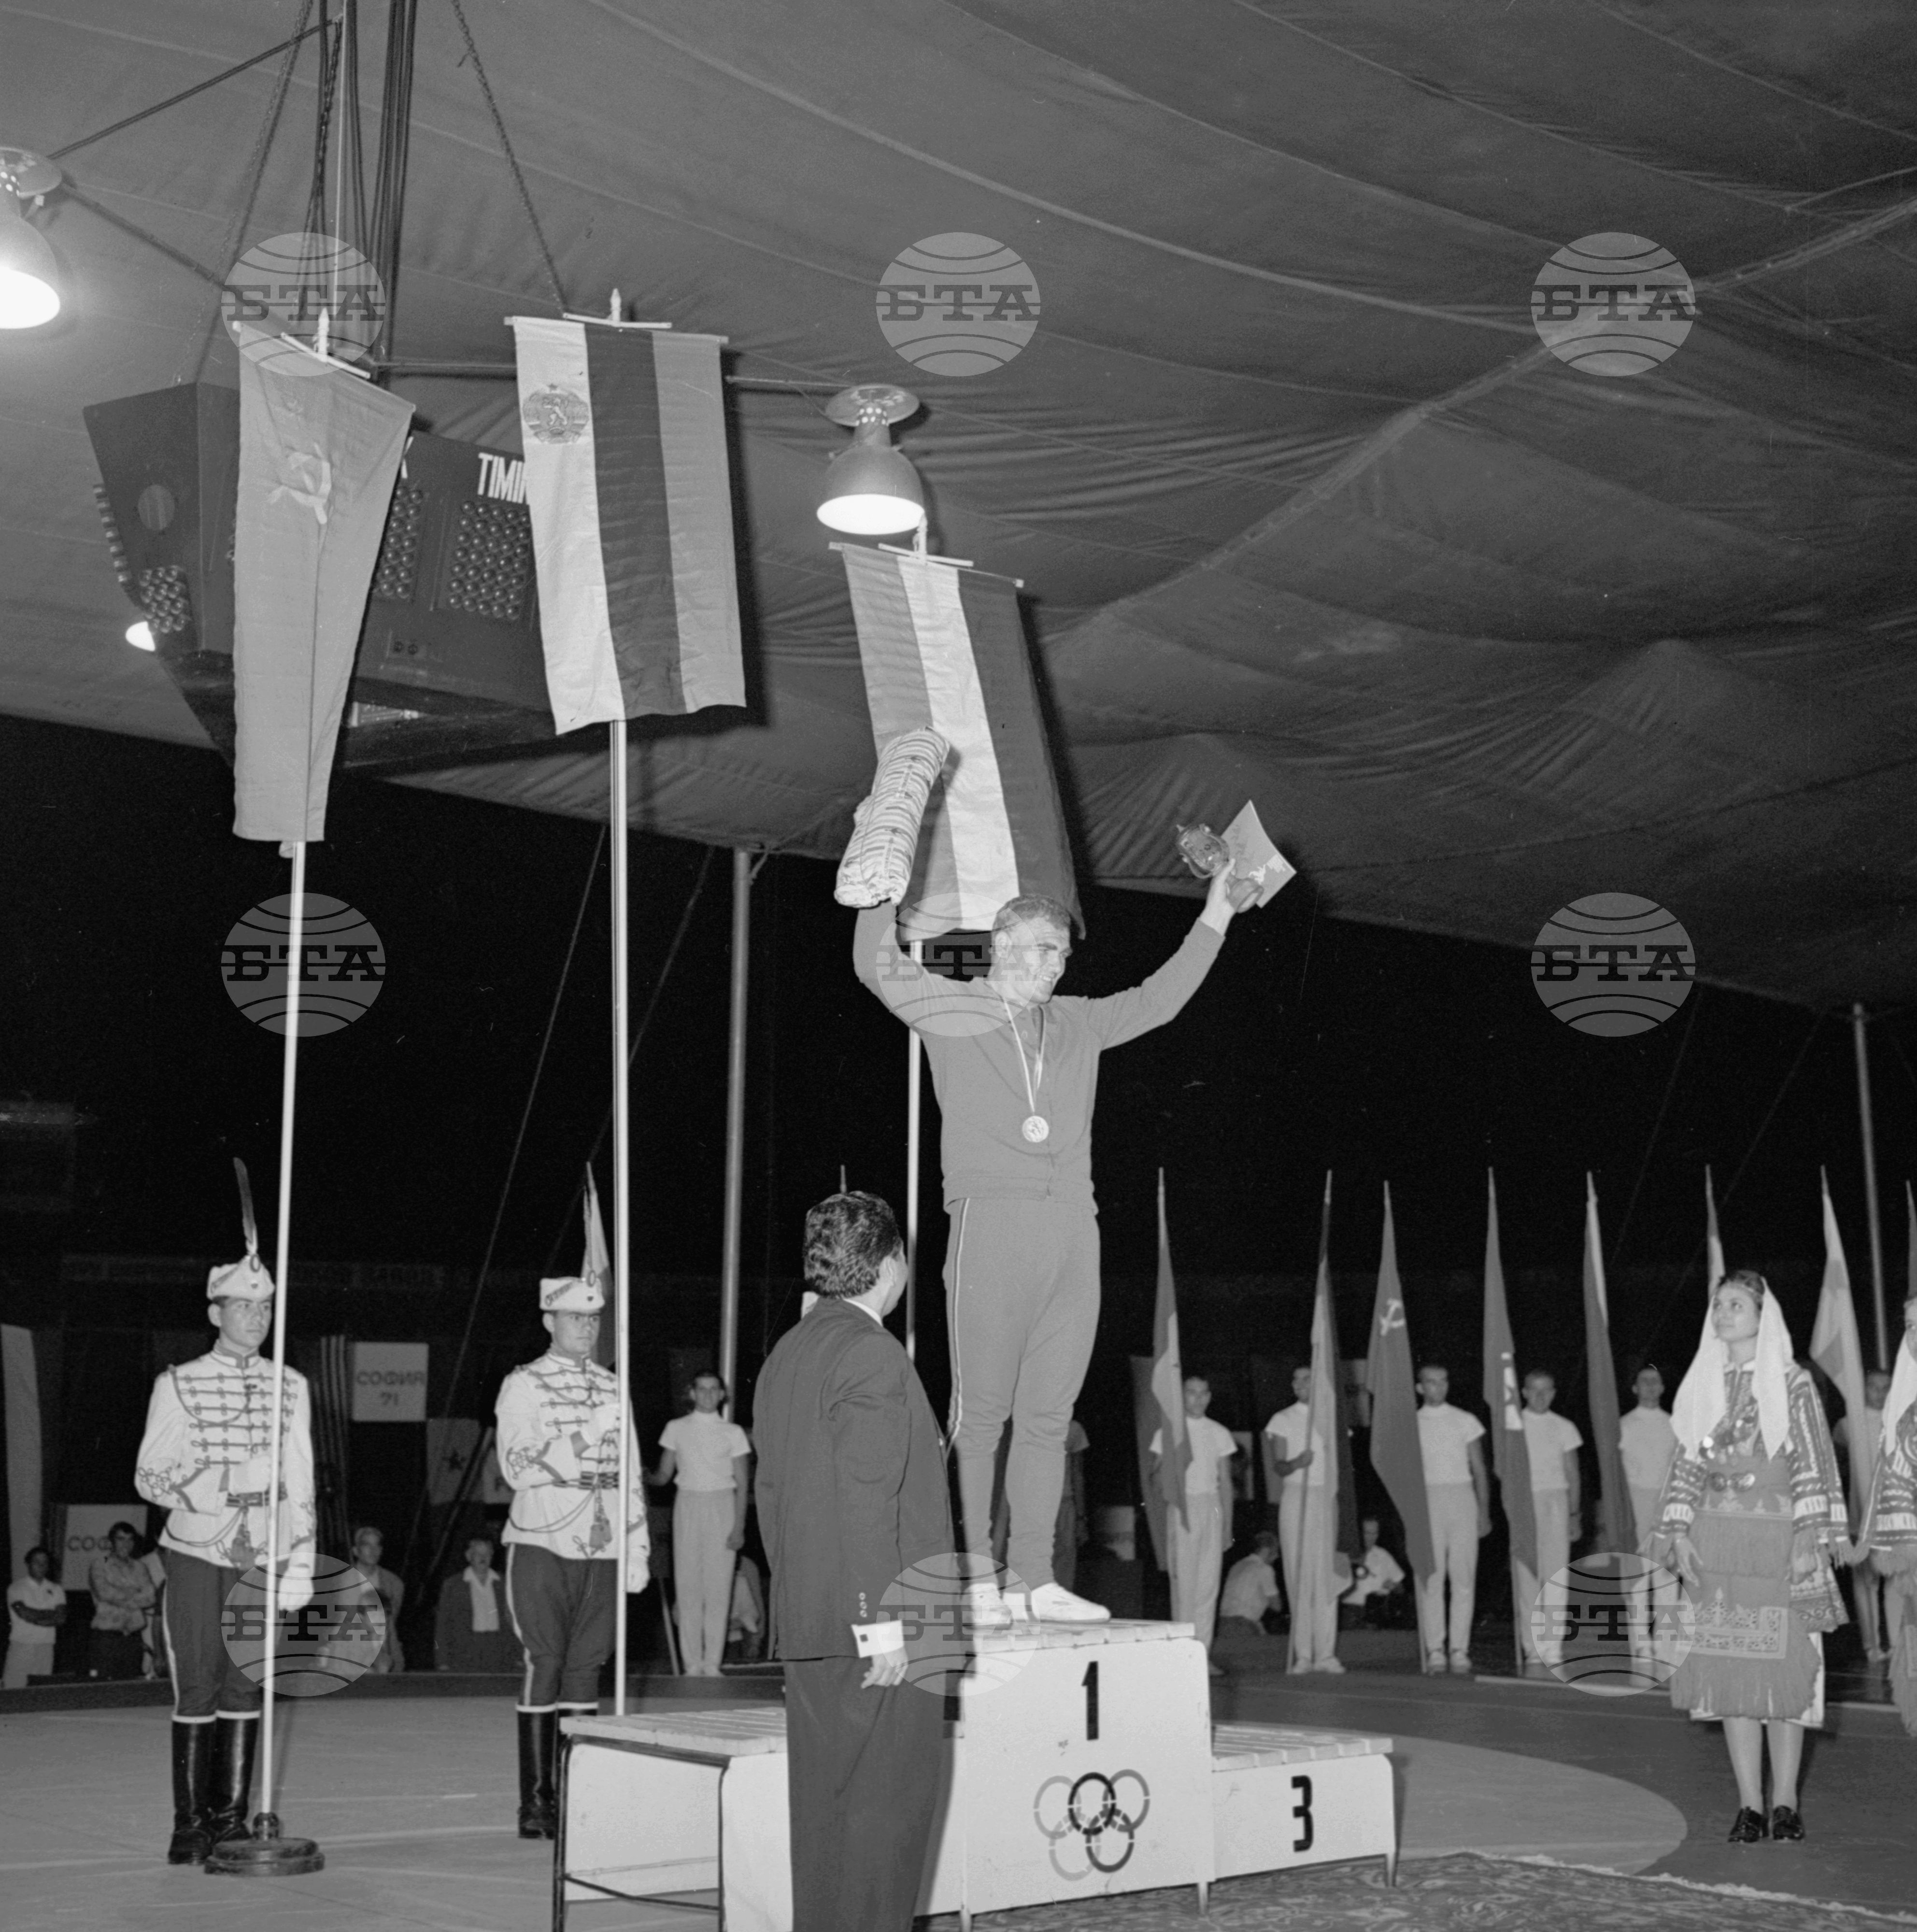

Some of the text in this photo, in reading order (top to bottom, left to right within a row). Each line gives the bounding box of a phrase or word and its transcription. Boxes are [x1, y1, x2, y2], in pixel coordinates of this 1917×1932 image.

[357, 1370, 425, 1385] СОФИЯ
[1082, 1662, 1098, 1740] 1
[1292, 1776, 1313, 1852] 3
